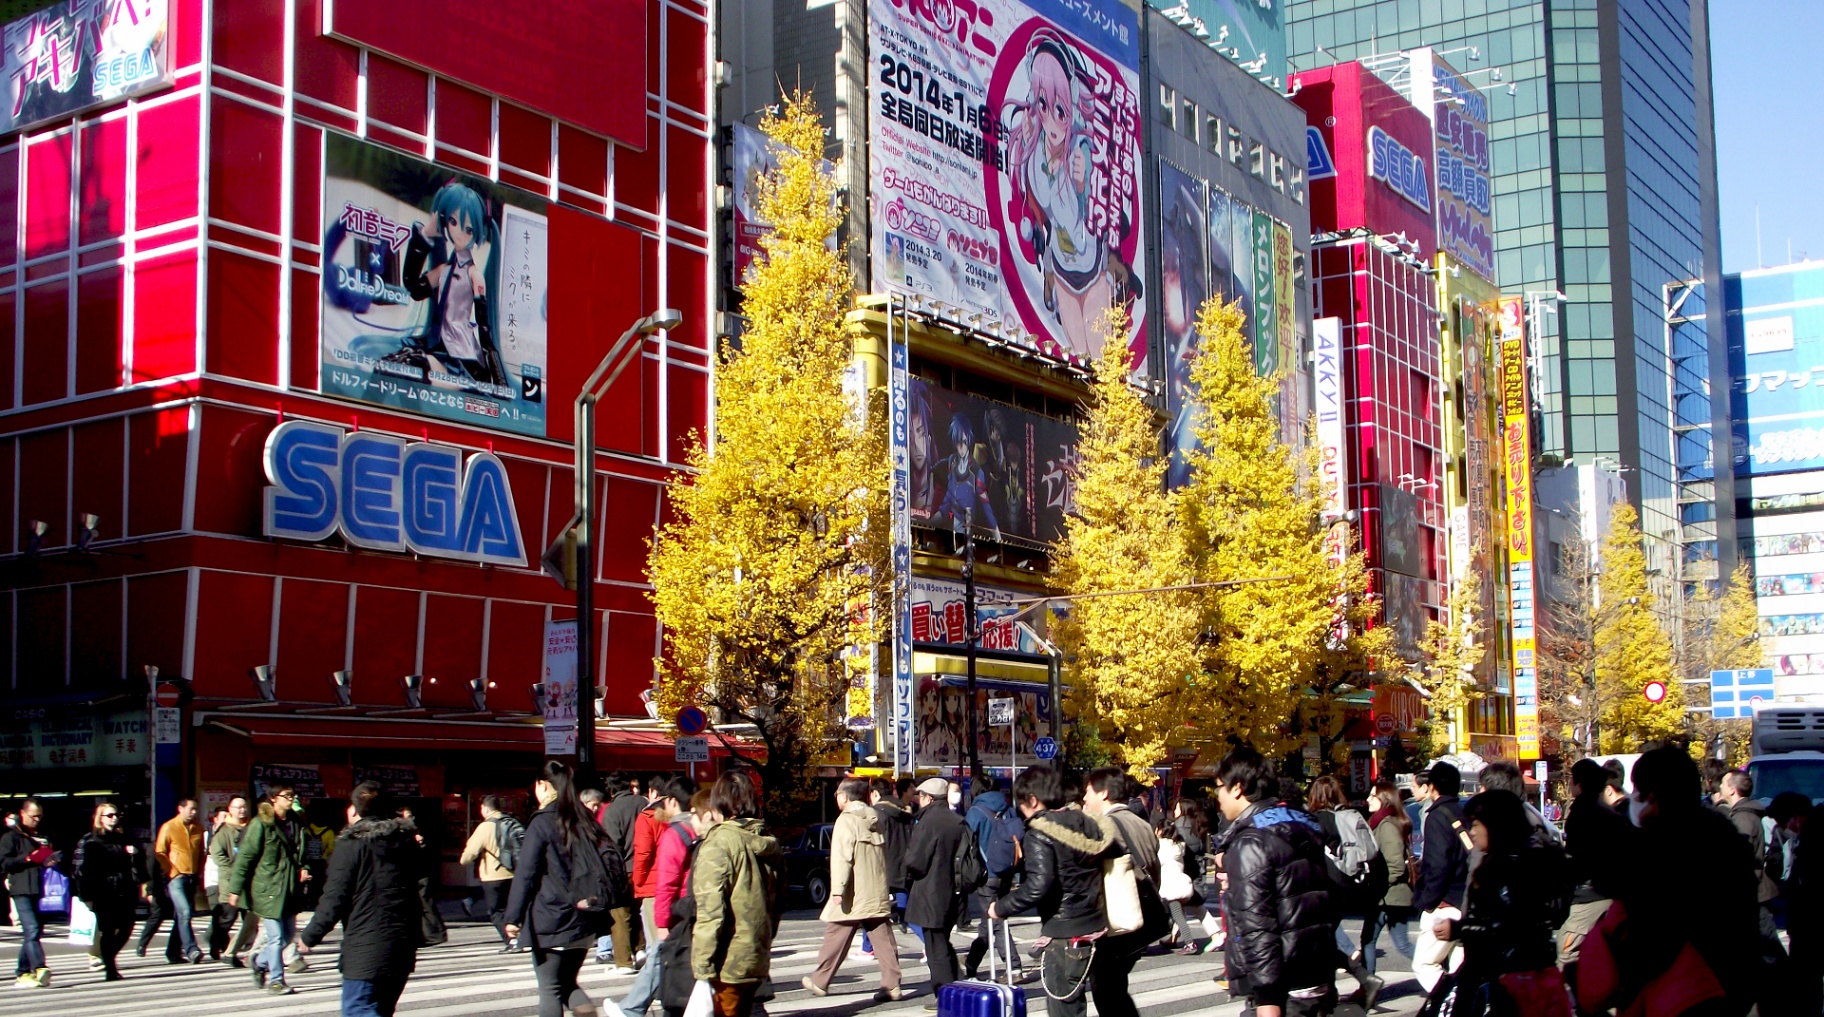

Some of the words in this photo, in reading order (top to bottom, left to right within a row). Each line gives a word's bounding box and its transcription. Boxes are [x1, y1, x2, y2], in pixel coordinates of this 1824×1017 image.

[1061, 0, 1129, 46] ューズメント館
[94, 48, 154, 96] SEGA
[881, 140, 904, 158] Twitter
[905, 138, 932, 157] Website
[1368, 125, 1431, 215] SEGA
[1437, 147, 1490, 217] 高額買取
[340, 201, 412, 252] 初音ミク
[905, 239, 943, 262] 2014.3.20
[905, 252, 929, 270] 発売予定
[915, 281, 933, 292] PS3
[964, 275, 987, 292] 発売予定
[507, 265, 519, 351] ミクが来る。
[1503, 340, 1520, 349] DVD
[1317, 334, 1338, 405] AKKY
[1504, 357, 1521, 365] ゲーム
[1507, 365, 1519, 374] CD
[1505, 381, 1522, 390] アニメ
[268, 423, 524, 563] SEGA
[1507, 421, 1528, 556] お売り下さい。
[912, 600, 1021, 651] 買い替応援!
[104, 720, 148, 735] WATCH
[898, 683, 911, 767] ソフマップ
[115, 738, 137, 754] 手表
[1036, 743, 1055, 753] 437
[1355, 758, 1367, 792] GAME
